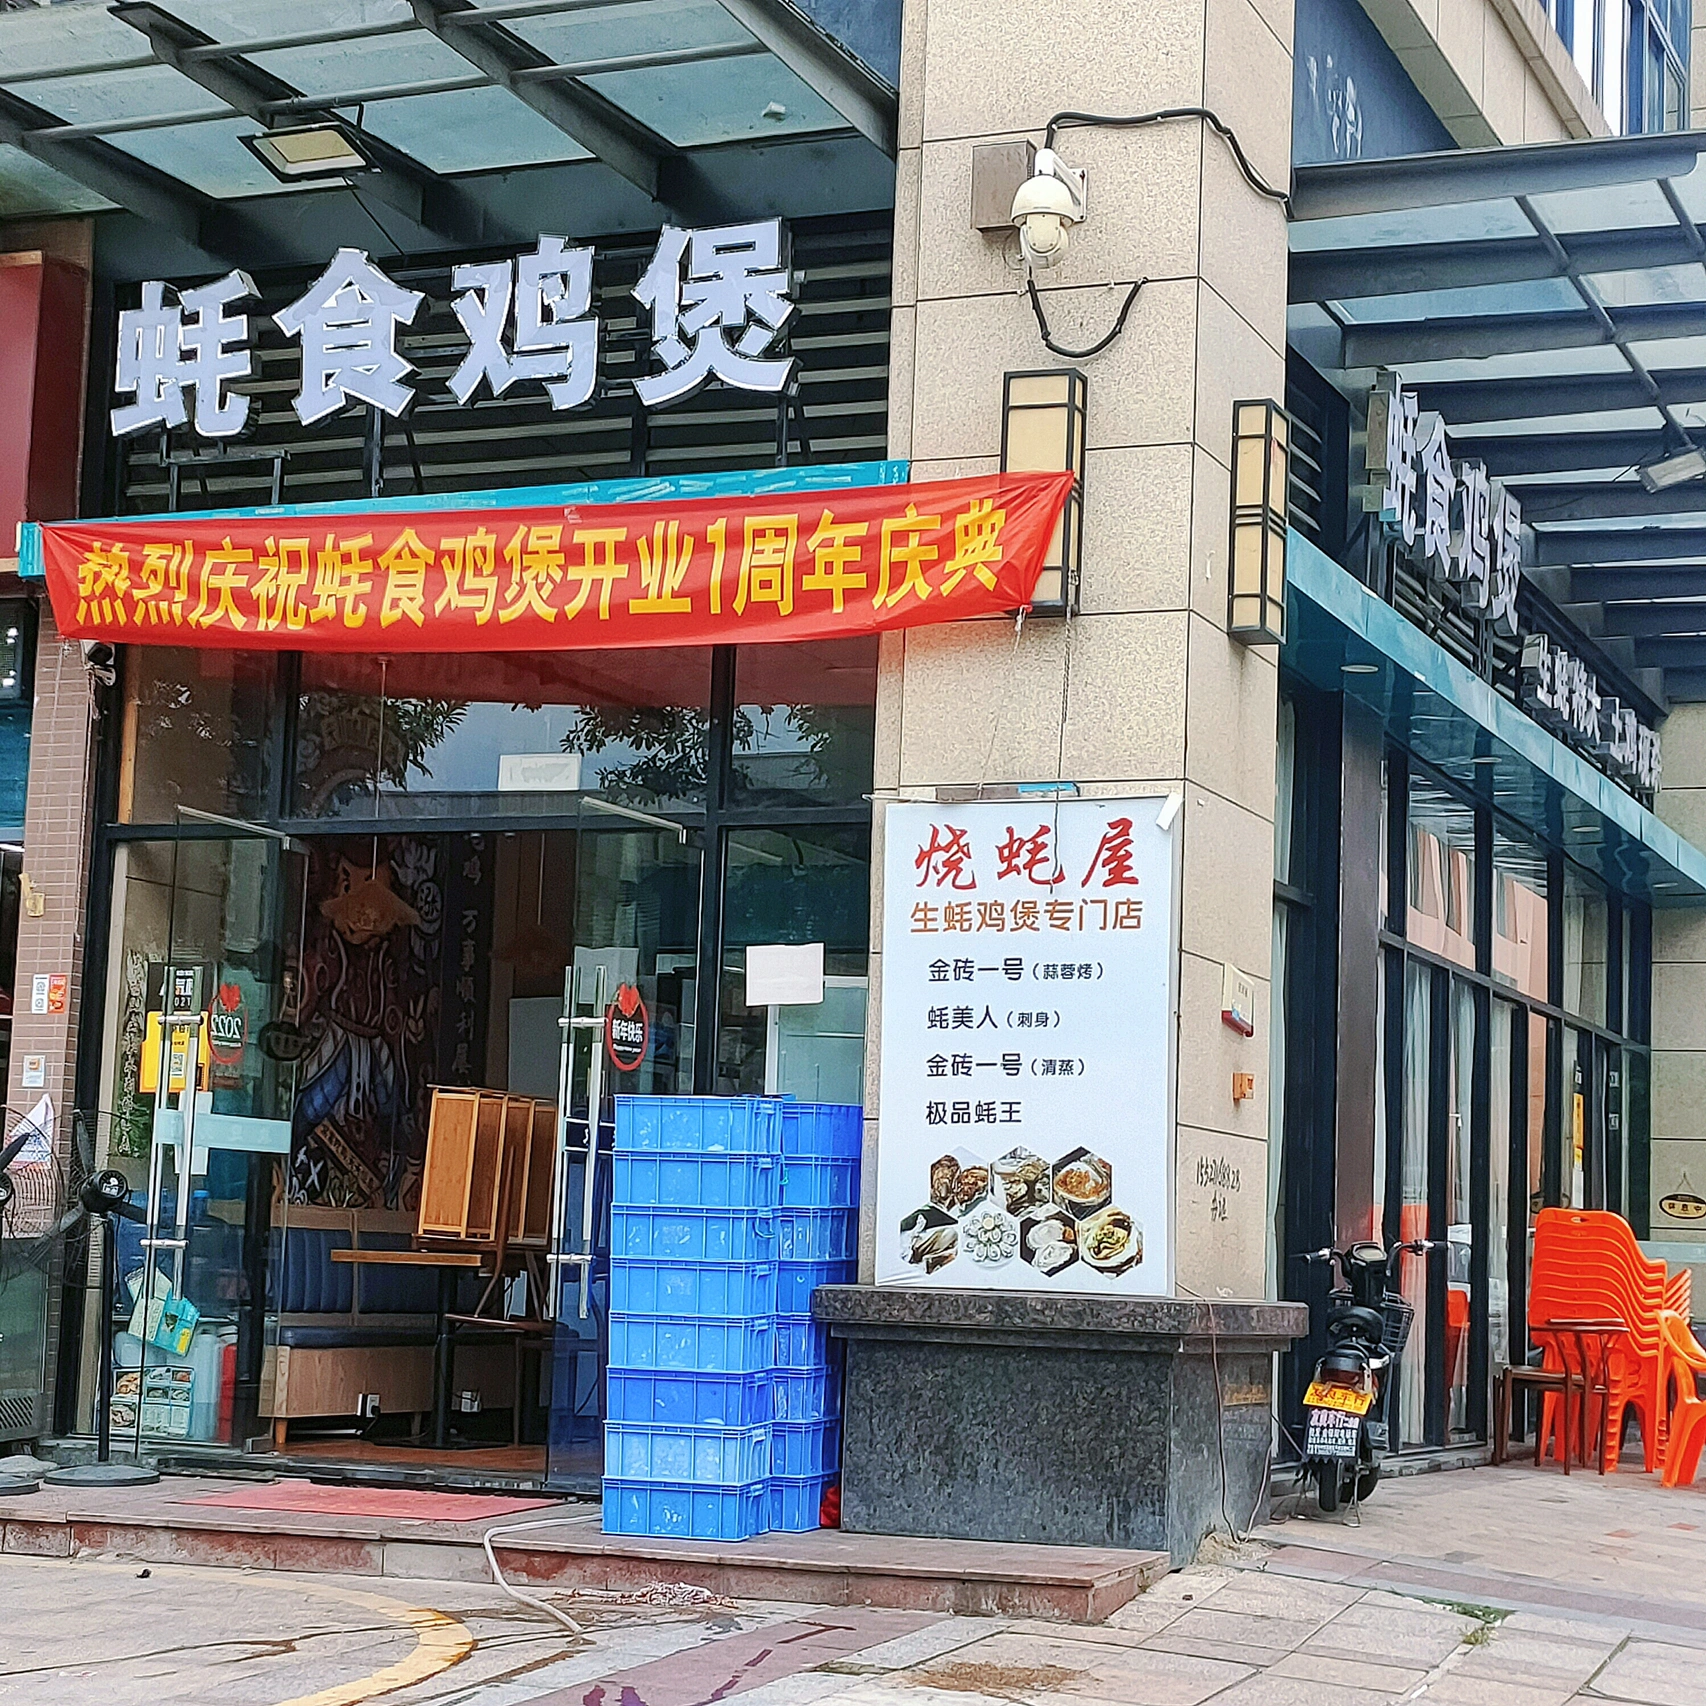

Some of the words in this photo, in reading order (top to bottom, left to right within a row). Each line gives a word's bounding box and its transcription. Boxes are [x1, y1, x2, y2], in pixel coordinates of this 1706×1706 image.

[110, 217, 798, 438] 蚝食鸡煲
[75, 498, 1006, 631] 热烈庆祝蚝食鸡煲开业1周年庆典
[914, 817, 1140, 890] 烧蚝屋
[910, 898, 1144, 933] 生蚝鸡煲专门店
[925, 1099, 1023, 1126] 极品蚝王
